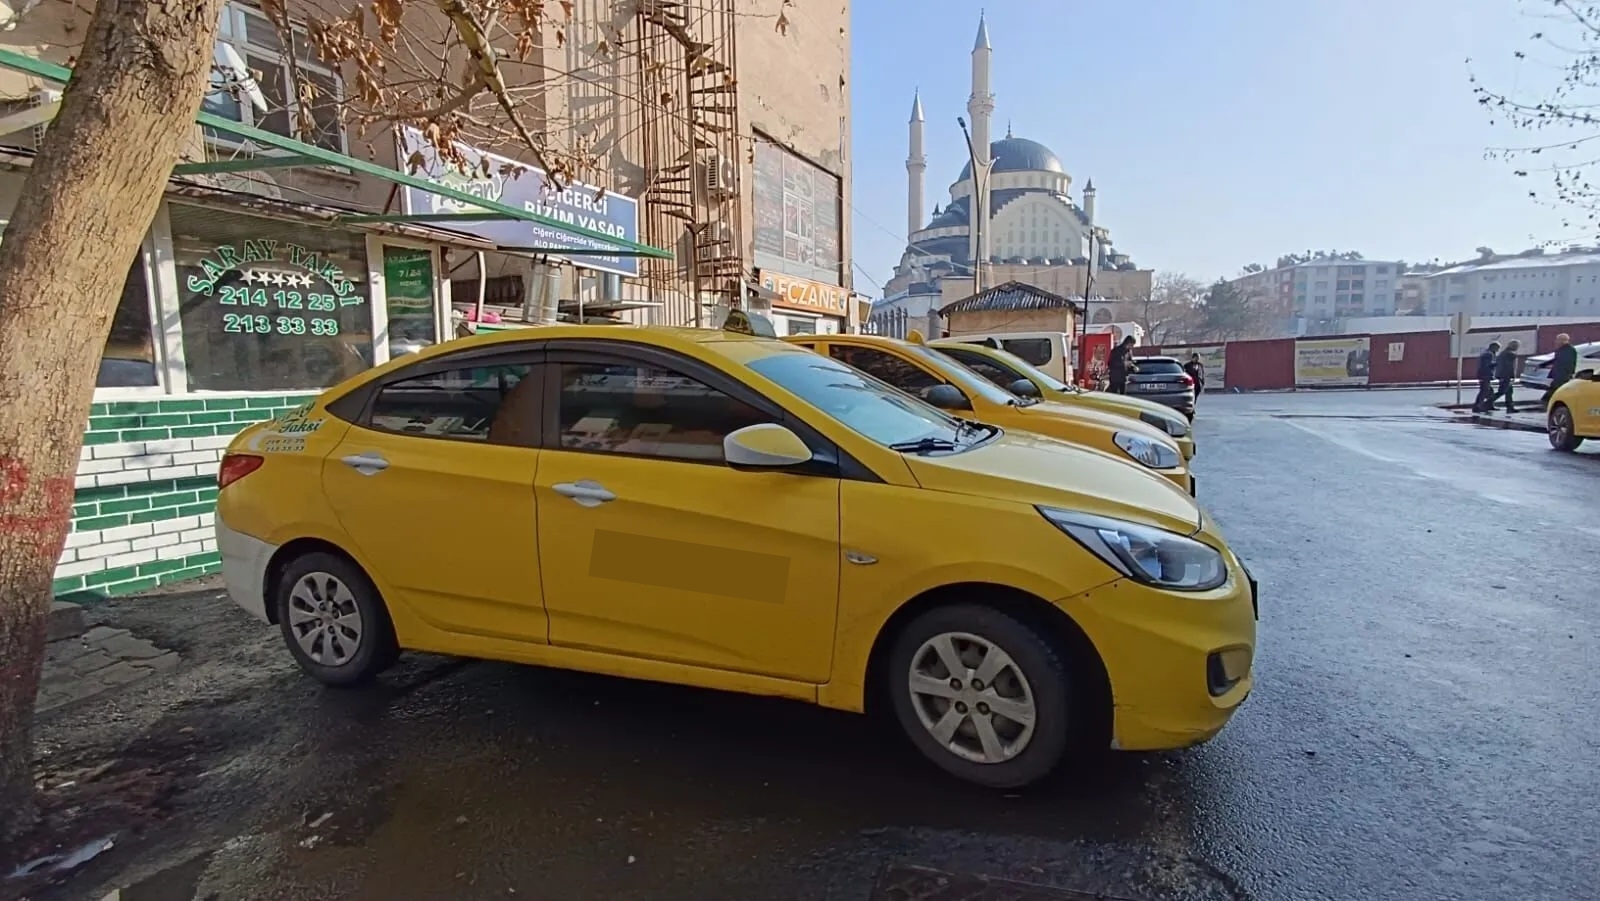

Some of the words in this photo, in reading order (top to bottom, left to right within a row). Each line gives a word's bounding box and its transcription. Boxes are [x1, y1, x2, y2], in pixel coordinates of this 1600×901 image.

[187, 239, 278, 296] SARAY
[219, 286, 268, 307] 214
[273, 290, 303, 310] 12
[307, 293, 336, 311] 25
[778, 278, 837, 310] ECZANE
[223, 313, 271, 333] 213
[276, 316, 306, 334] 33
[310, 318, 339, 336] 33
